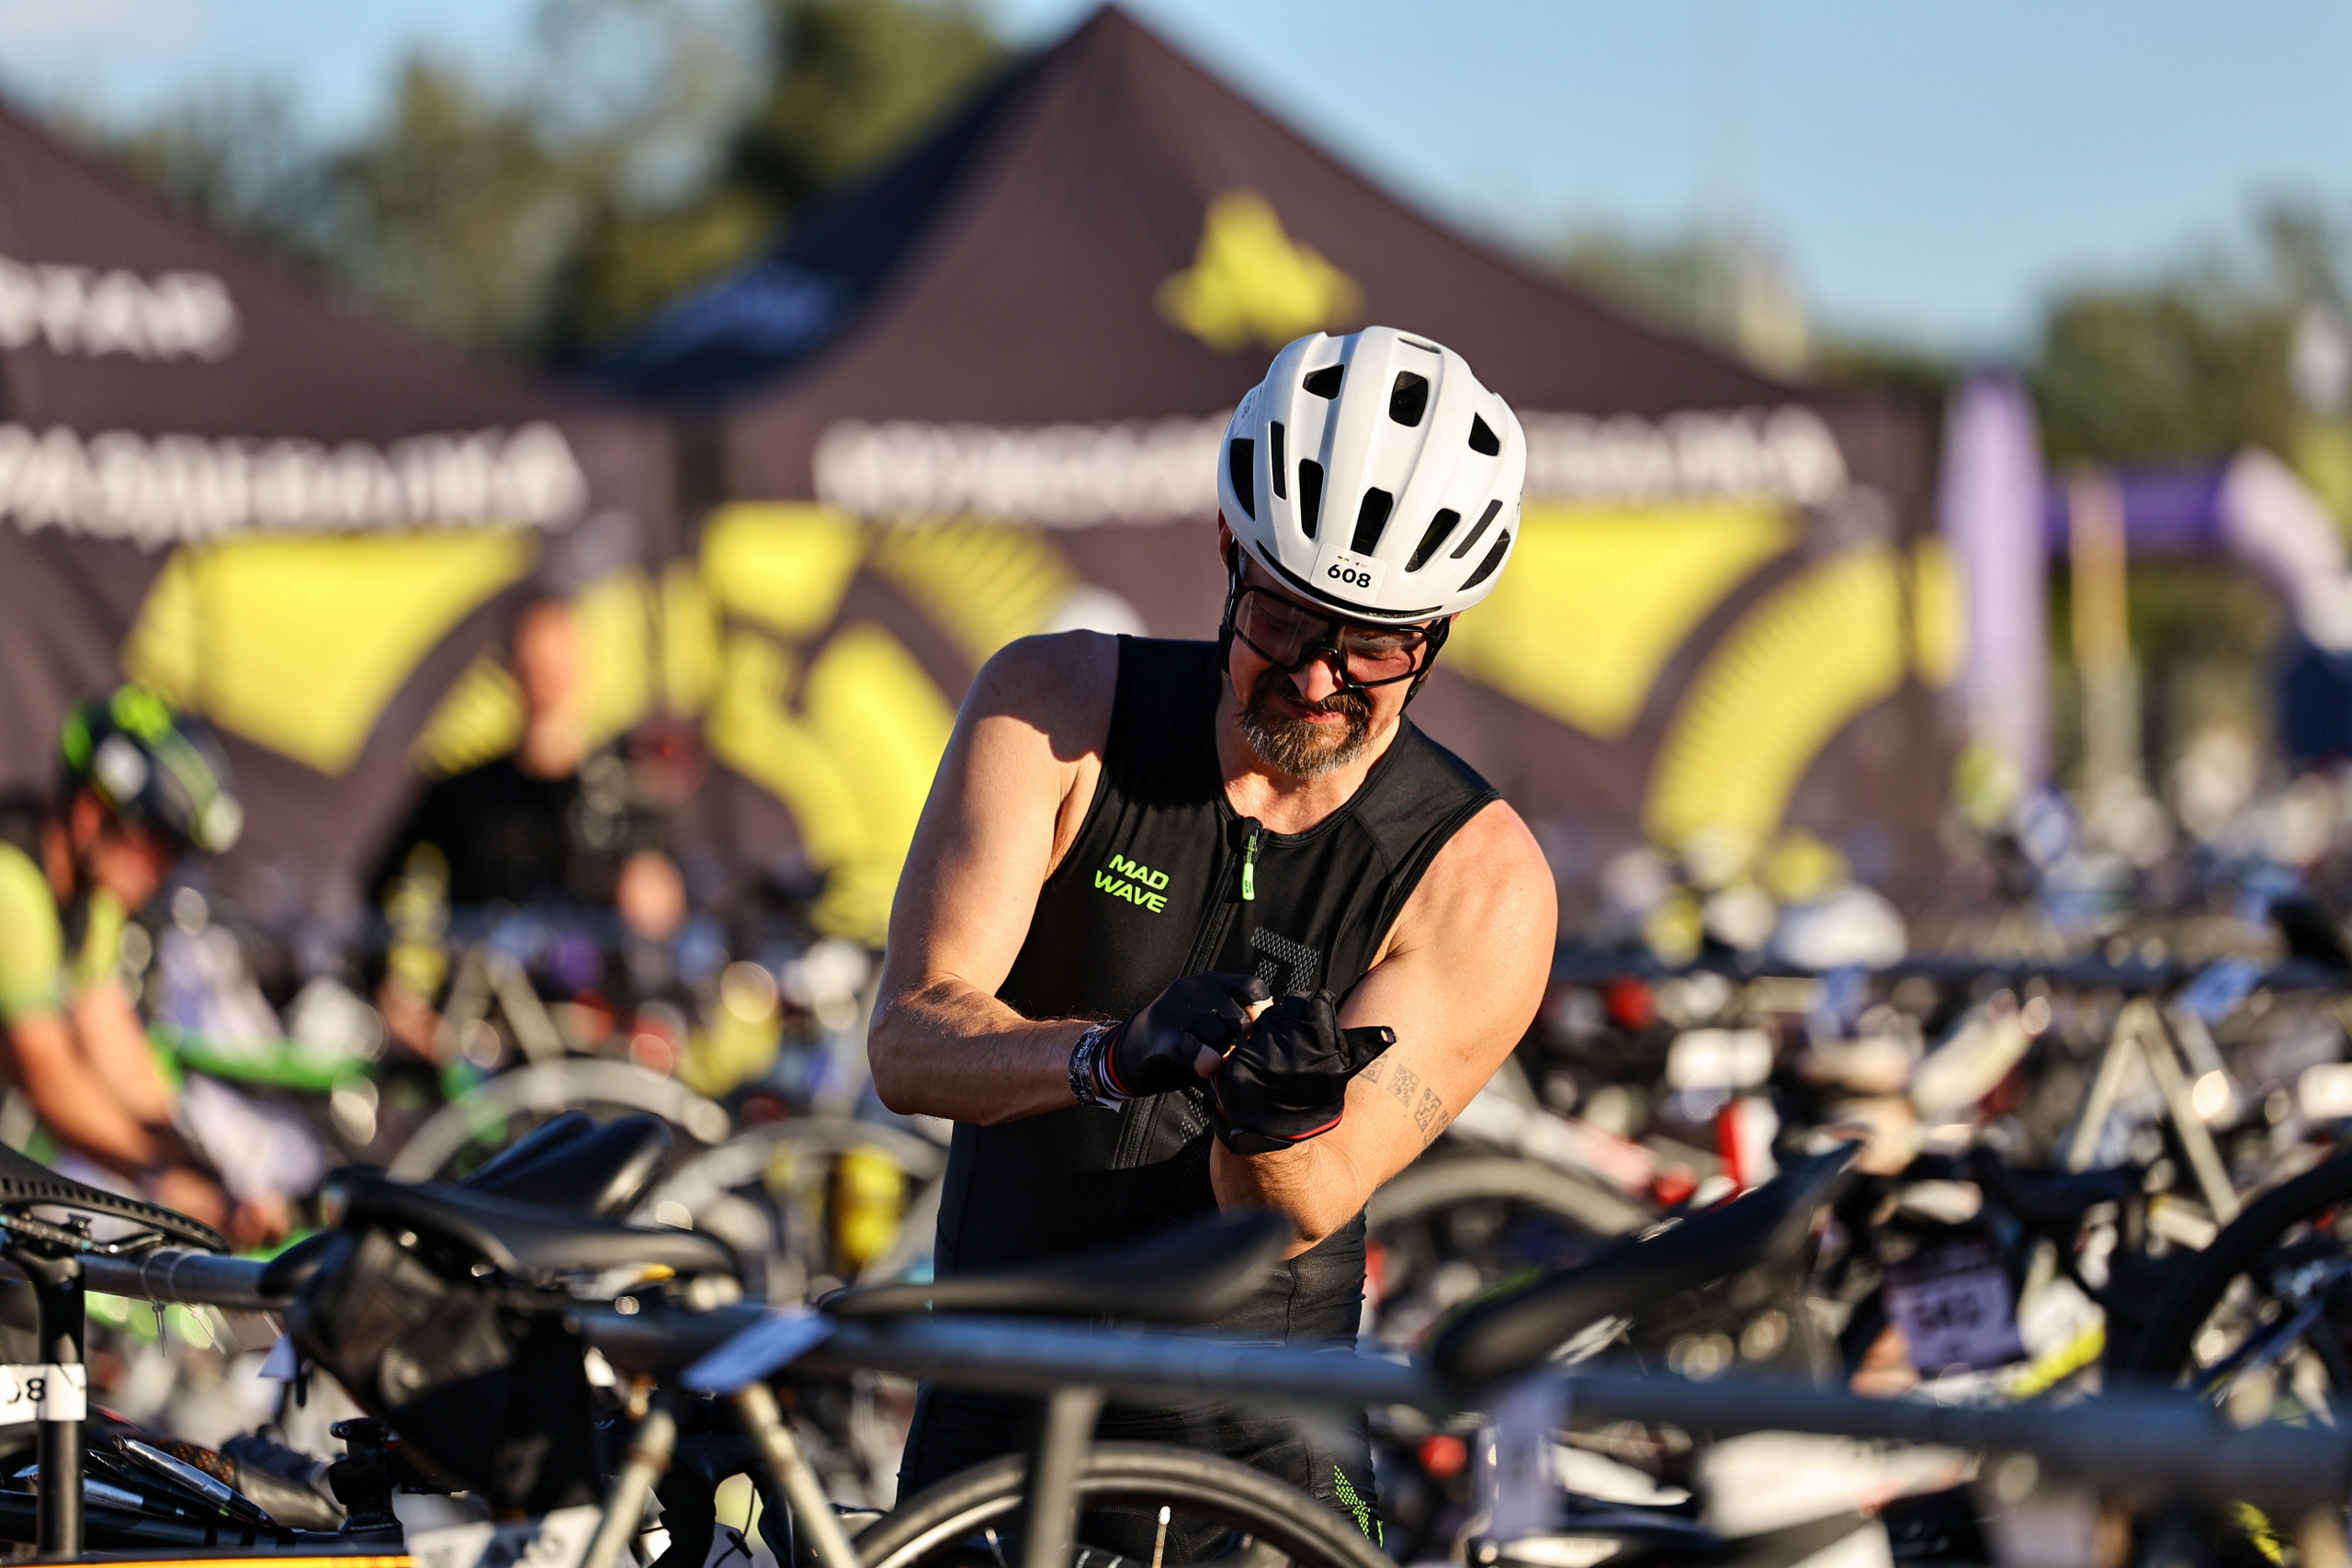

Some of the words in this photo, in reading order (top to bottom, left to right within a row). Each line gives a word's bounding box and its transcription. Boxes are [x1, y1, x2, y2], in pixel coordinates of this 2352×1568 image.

[1327, 564, 1372, 589] 608
[1108, 853, 1170, 891] MAD
[1094, 869, 1169, 914] WAVE
